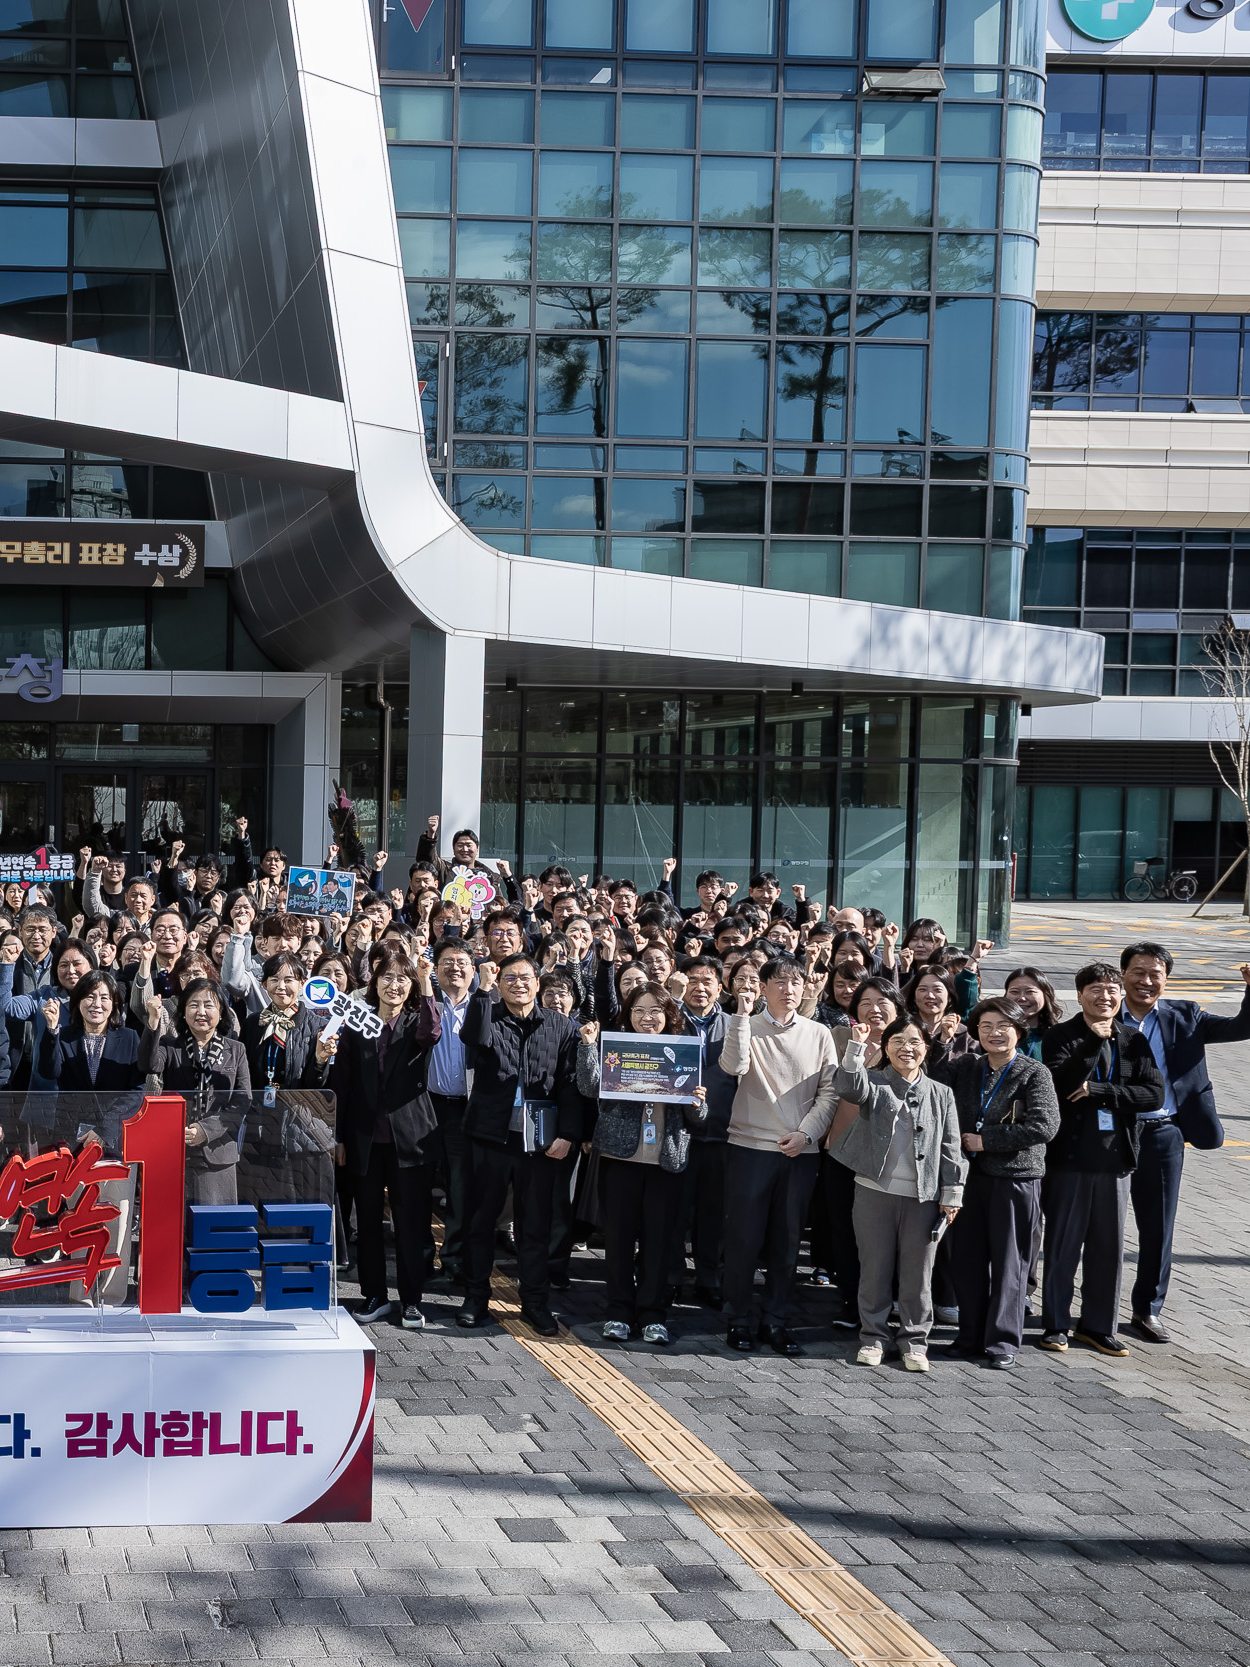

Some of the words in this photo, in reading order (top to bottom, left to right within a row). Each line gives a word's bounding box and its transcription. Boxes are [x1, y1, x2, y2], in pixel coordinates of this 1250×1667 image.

[78, 543, 127, 566] 표창
[134, 543, 183, 567] 수상
[23, 870, 76, 882] 덕분입니다
[333, 996, 383, 1038] 광진구
[65, 1410, 314, 1459] 감사합니다.
